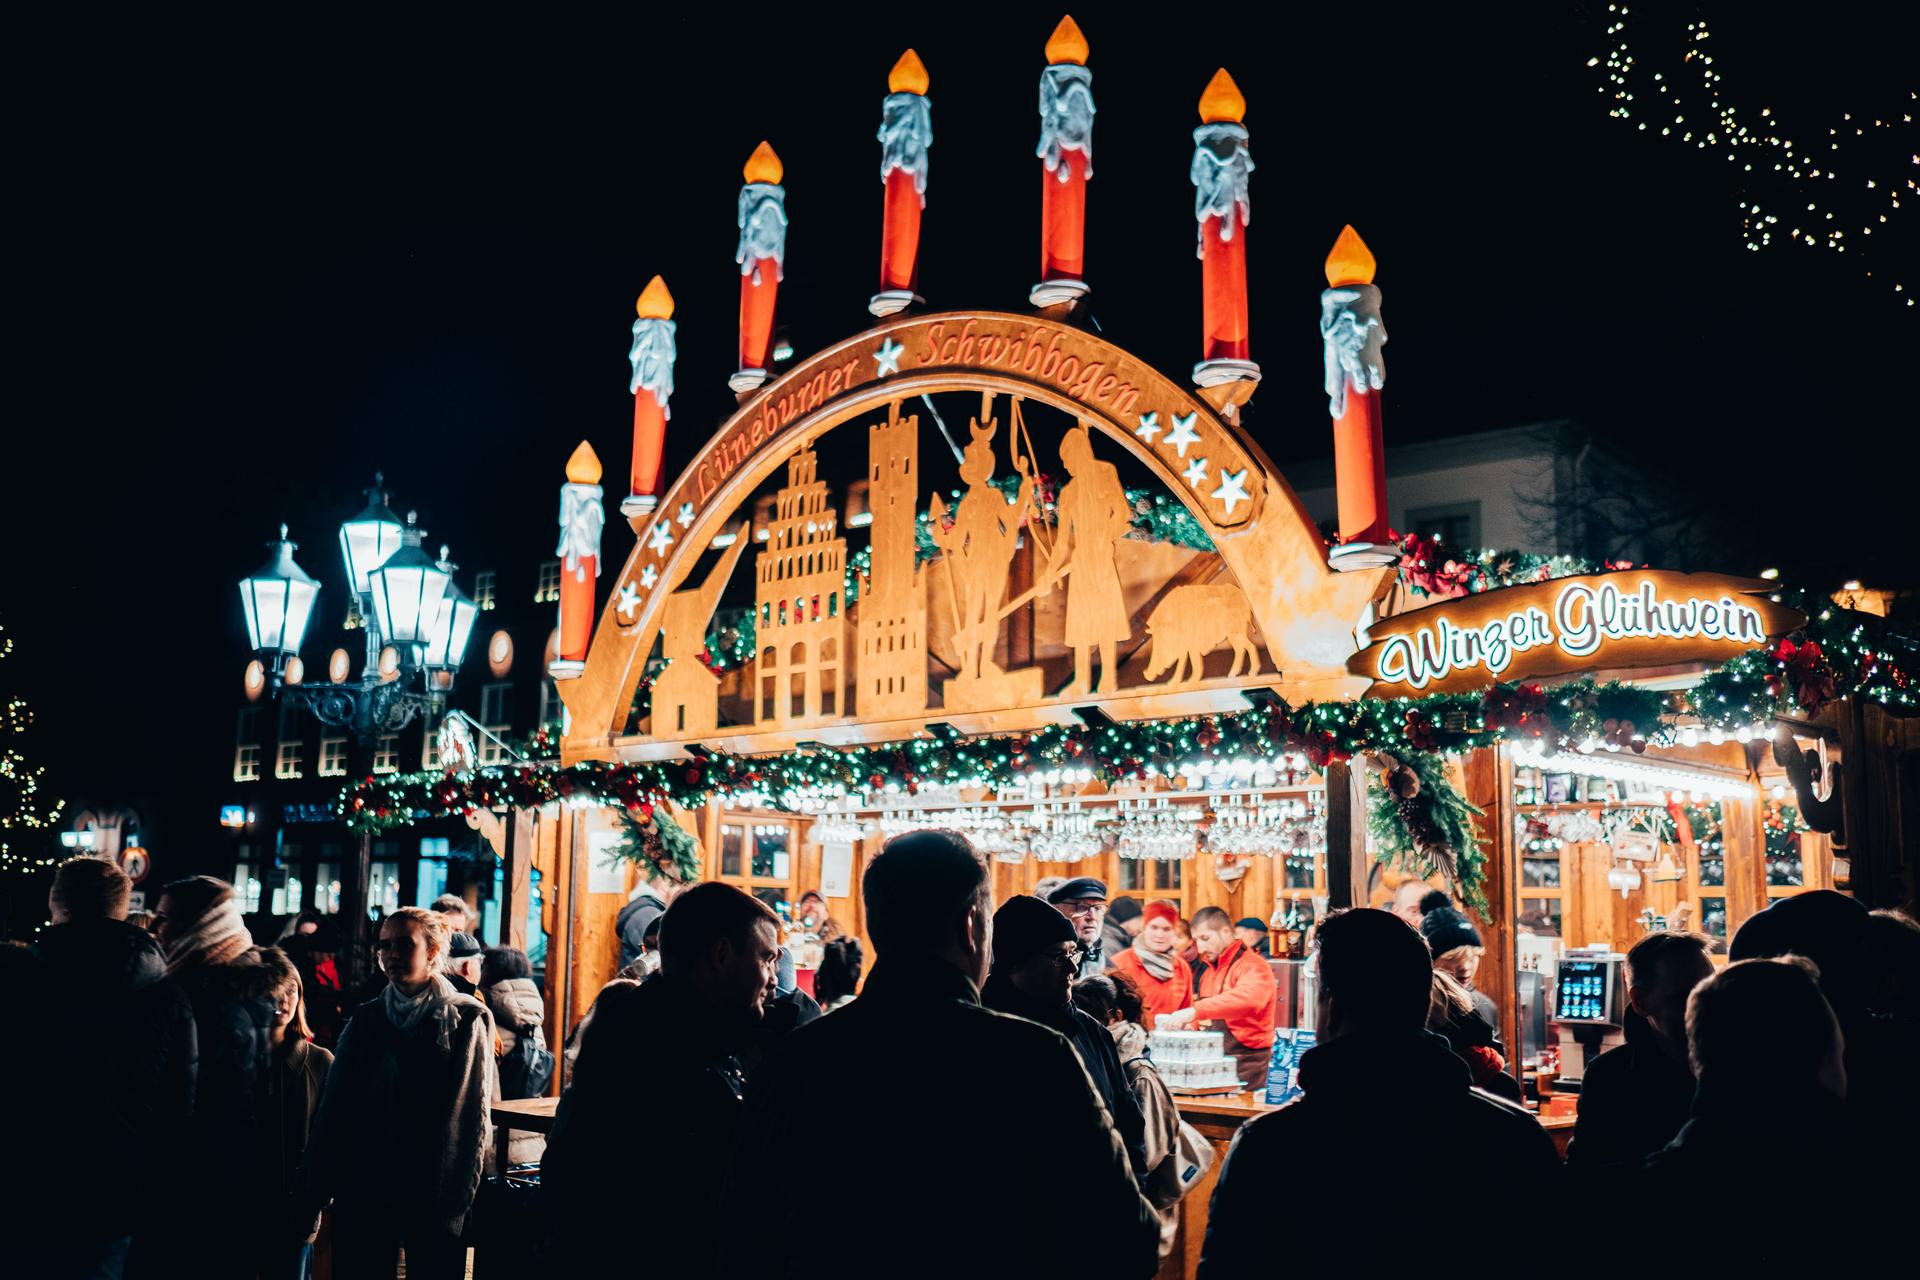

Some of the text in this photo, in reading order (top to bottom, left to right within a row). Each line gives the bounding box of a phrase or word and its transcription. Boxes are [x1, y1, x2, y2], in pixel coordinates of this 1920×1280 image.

[697, 317, 1141, 505] Lüneburger Schwibbogen
[1378, 580, 1765, 687] Winzer Glühwein
